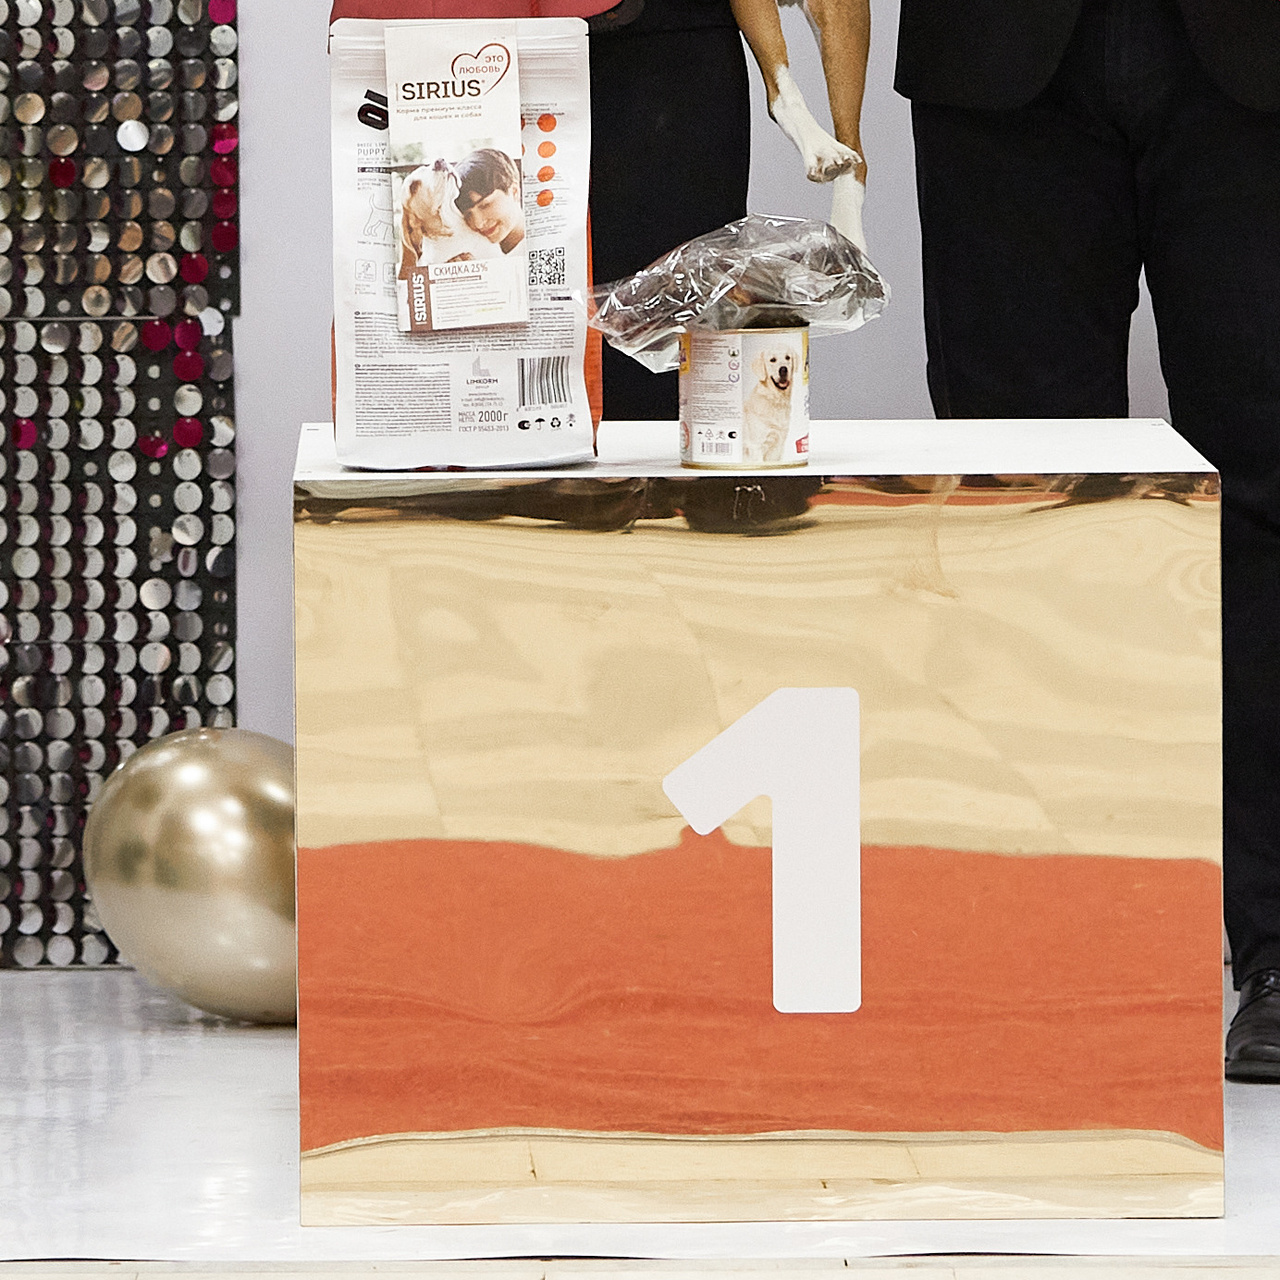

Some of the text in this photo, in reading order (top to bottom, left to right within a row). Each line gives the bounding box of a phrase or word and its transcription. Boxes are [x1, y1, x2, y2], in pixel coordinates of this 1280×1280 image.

[484, 55, 504, 63] ЭТО
[459, 65, 501, 74] ЛЮБОВЬ
[401, 79, 482, 101] SIRIUS
[357, 147, 386, 156] PUPPY
[433, 262, 488, 276] СКИДКА 25%
[412, 273, 428, 323] SIRIUS
[662, 686, 862, 1013] 1
